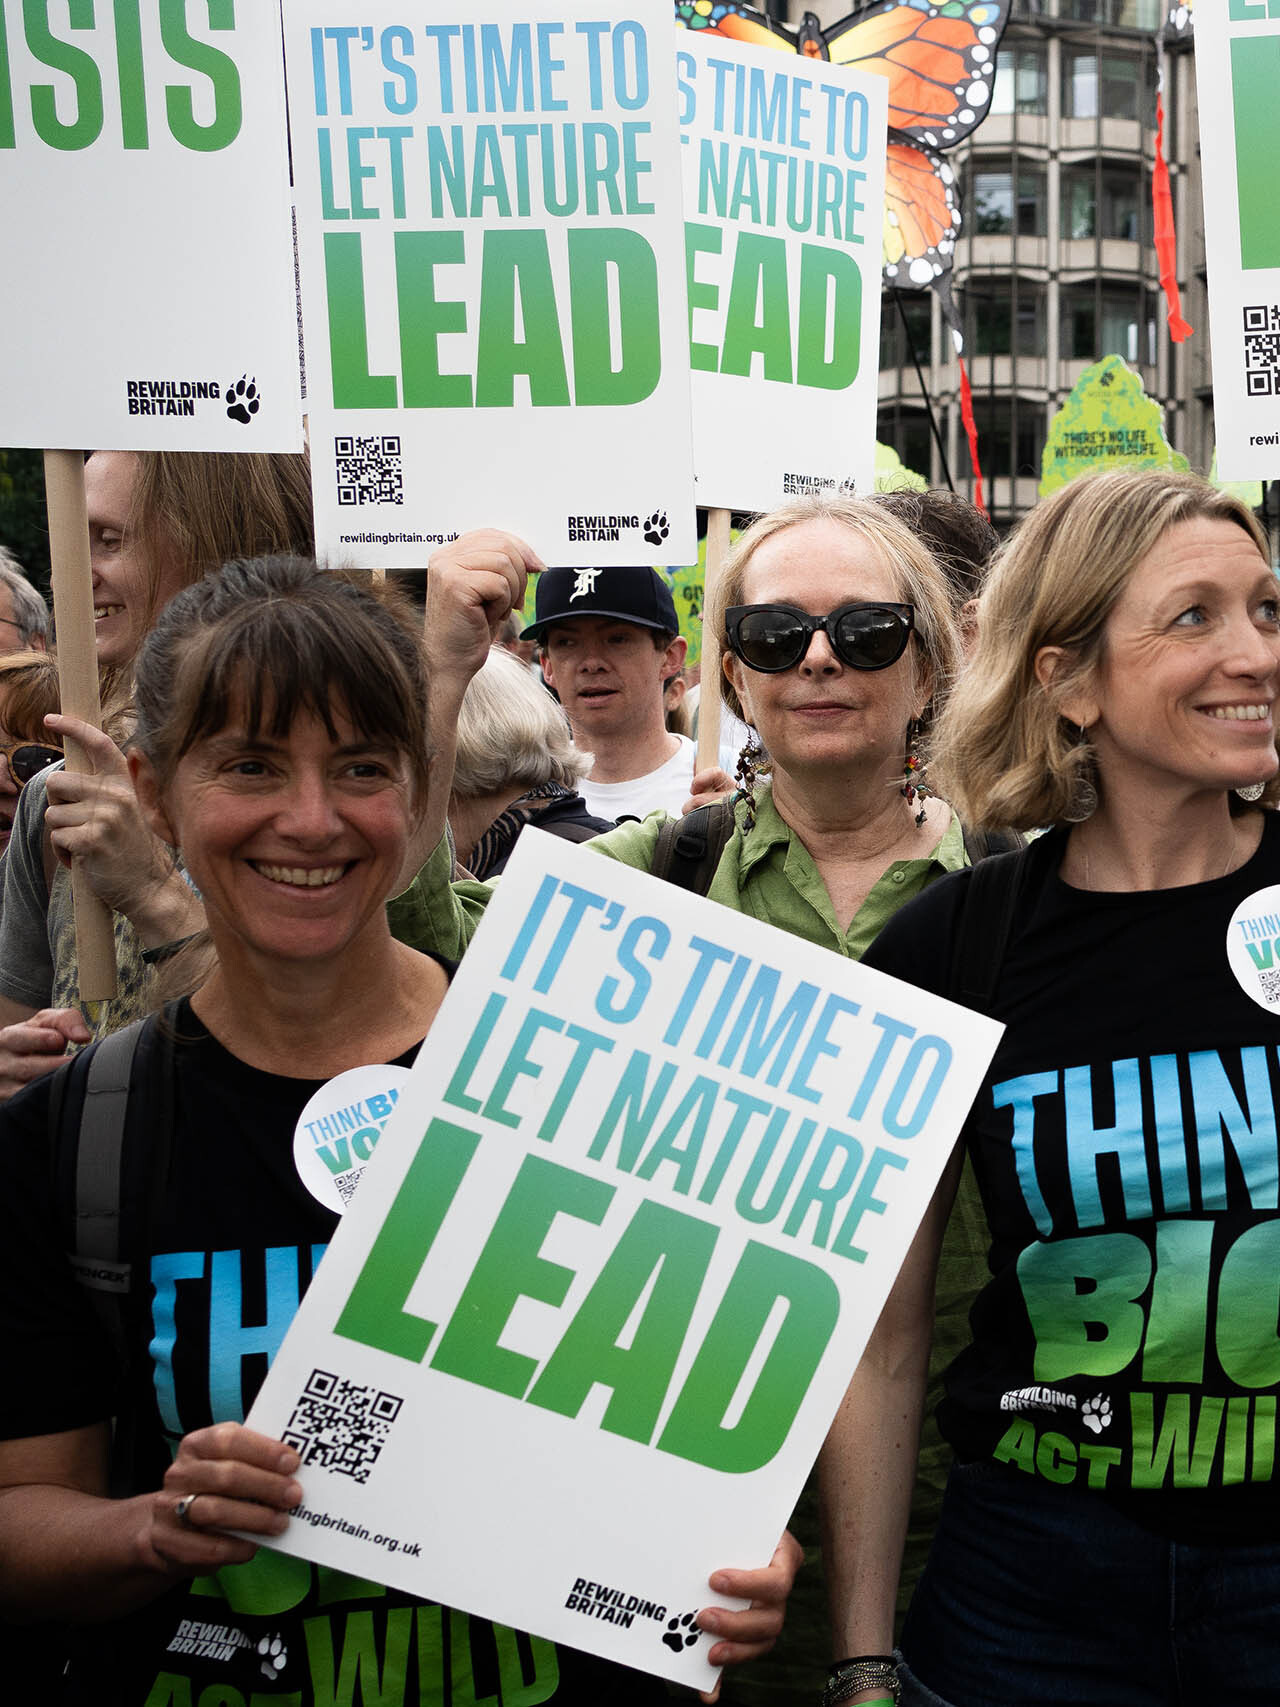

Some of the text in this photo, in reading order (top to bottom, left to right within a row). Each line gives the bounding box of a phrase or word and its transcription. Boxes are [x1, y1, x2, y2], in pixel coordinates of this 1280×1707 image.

[310, 25, 418, 117] IT'S
[426, 23, 569, 115] TIME
[576, 20, 650, 113] TO
[706, 57, 813, 151] TIME
[820, 84, 870, 163] TO
[317, 121, 656, 221] LET NATURE
[698, 138, 868, 246] NATURE
[323, 227, 662, 410] LEAD
[684, 222, 863, 391] EAD
[1055, 445, 1101, 458] WITHOUT
[1109, 431, 1123, 443] NO
[1125, 430, 1147, 442] LIFE
[499, 873, 953, 1140] IT'S TIME TO
[304, 1102, 371, 1145] THINK
[315, 1120, 388, 1176] VO
[442, 992, 909, 1265] LET NATURE
[332, 1117, 841, 1476] LEAD
[992, 1415, 1122, 1489] ACT
[288, 1504, 422, 1557] dingbritain.org.uk
[303, 1605, 561, 1707] WILD
